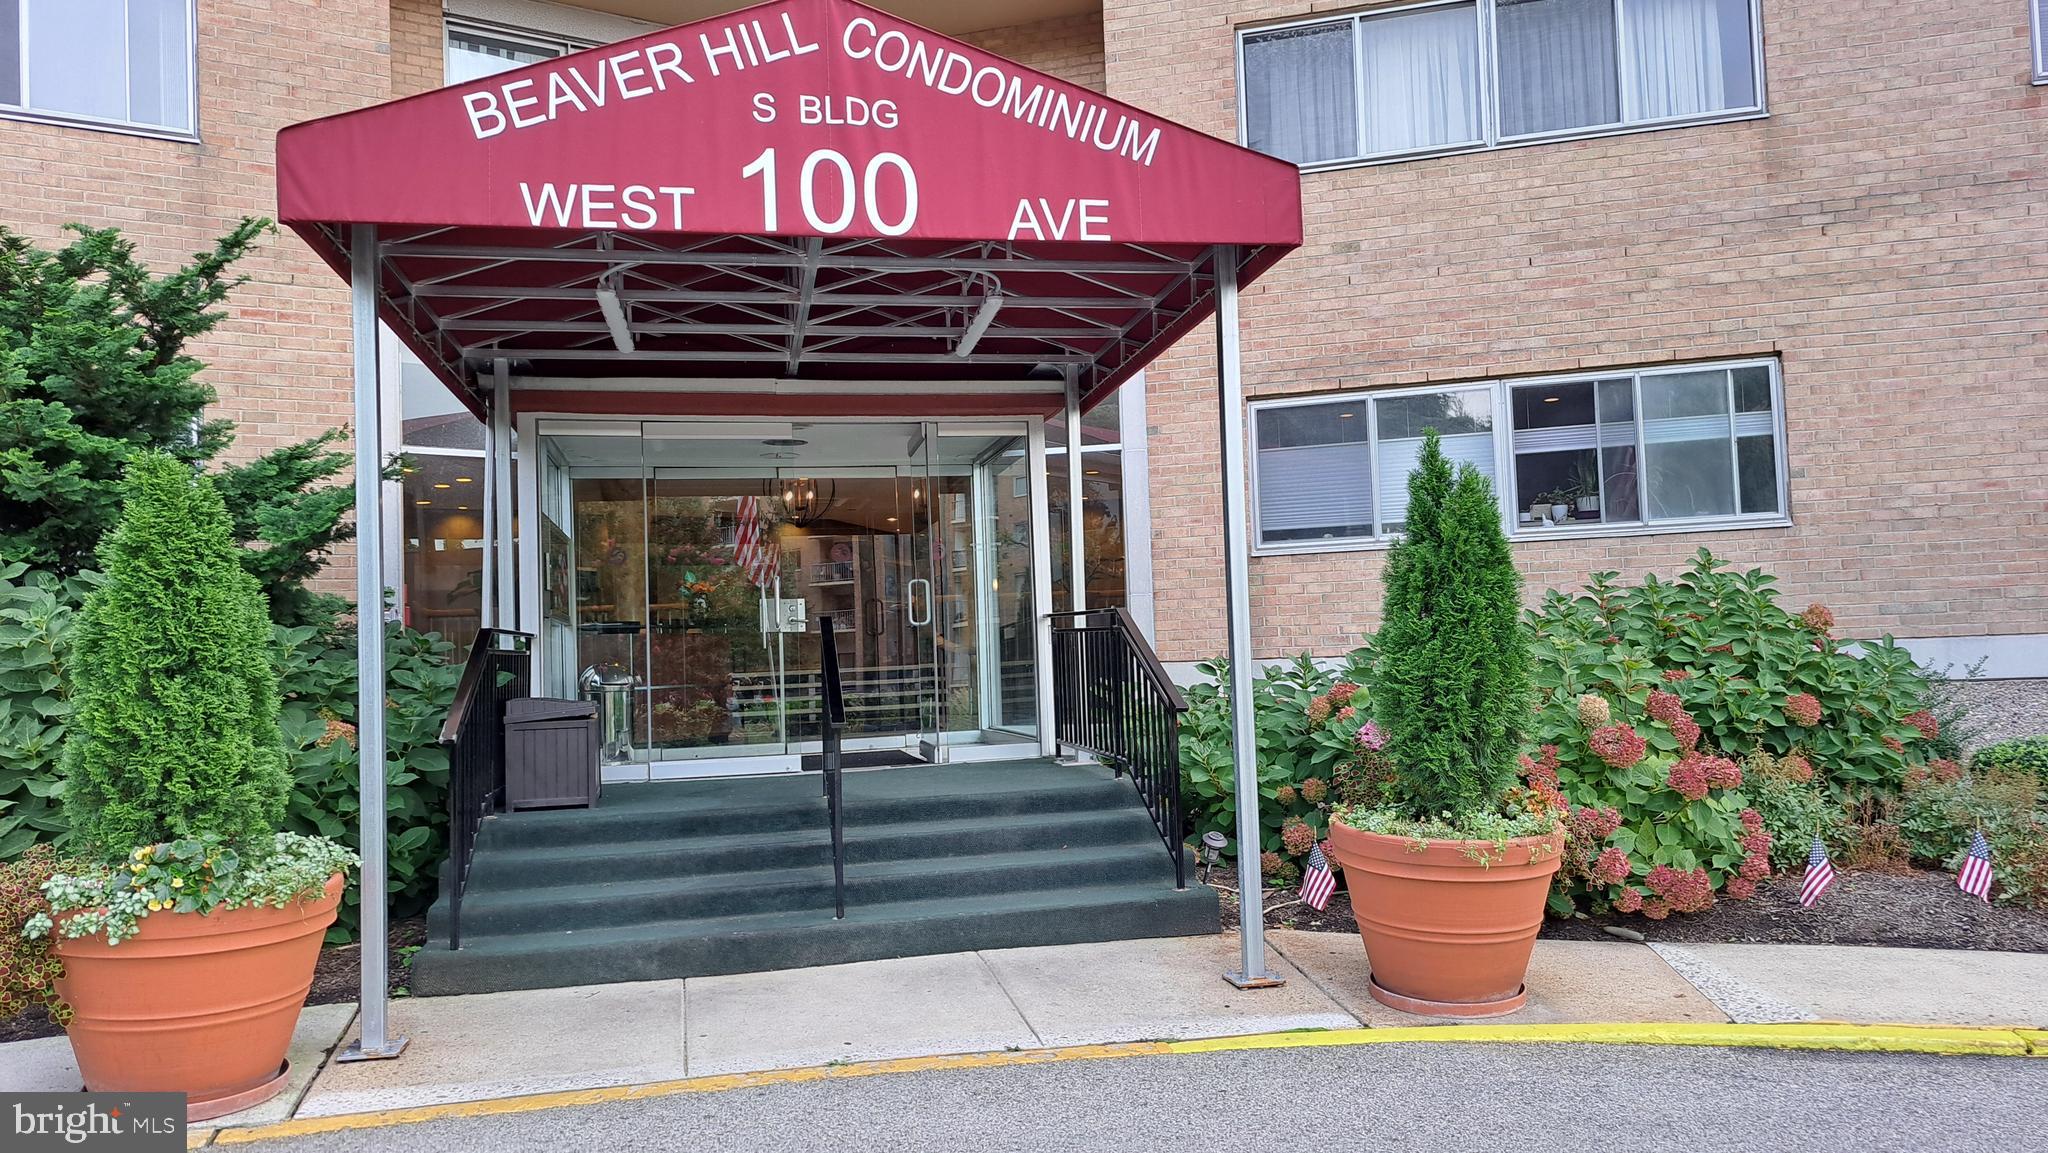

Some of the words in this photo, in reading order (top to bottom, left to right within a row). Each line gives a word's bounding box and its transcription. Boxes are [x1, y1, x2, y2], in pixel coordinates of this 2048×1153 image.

[462, 42, 695, 140] BEAVER
[699, 12, 820, 77] HILL
[842, 17, 1161, 167] CONDOMINIUM
[752, 92, 776, 123] S
[799, 94, 899, 129] BLDG
[519, 182, 695, 230] WEST
[742, 147, 918, 236] 100
[1007, 197, 1112, 241] AVE
